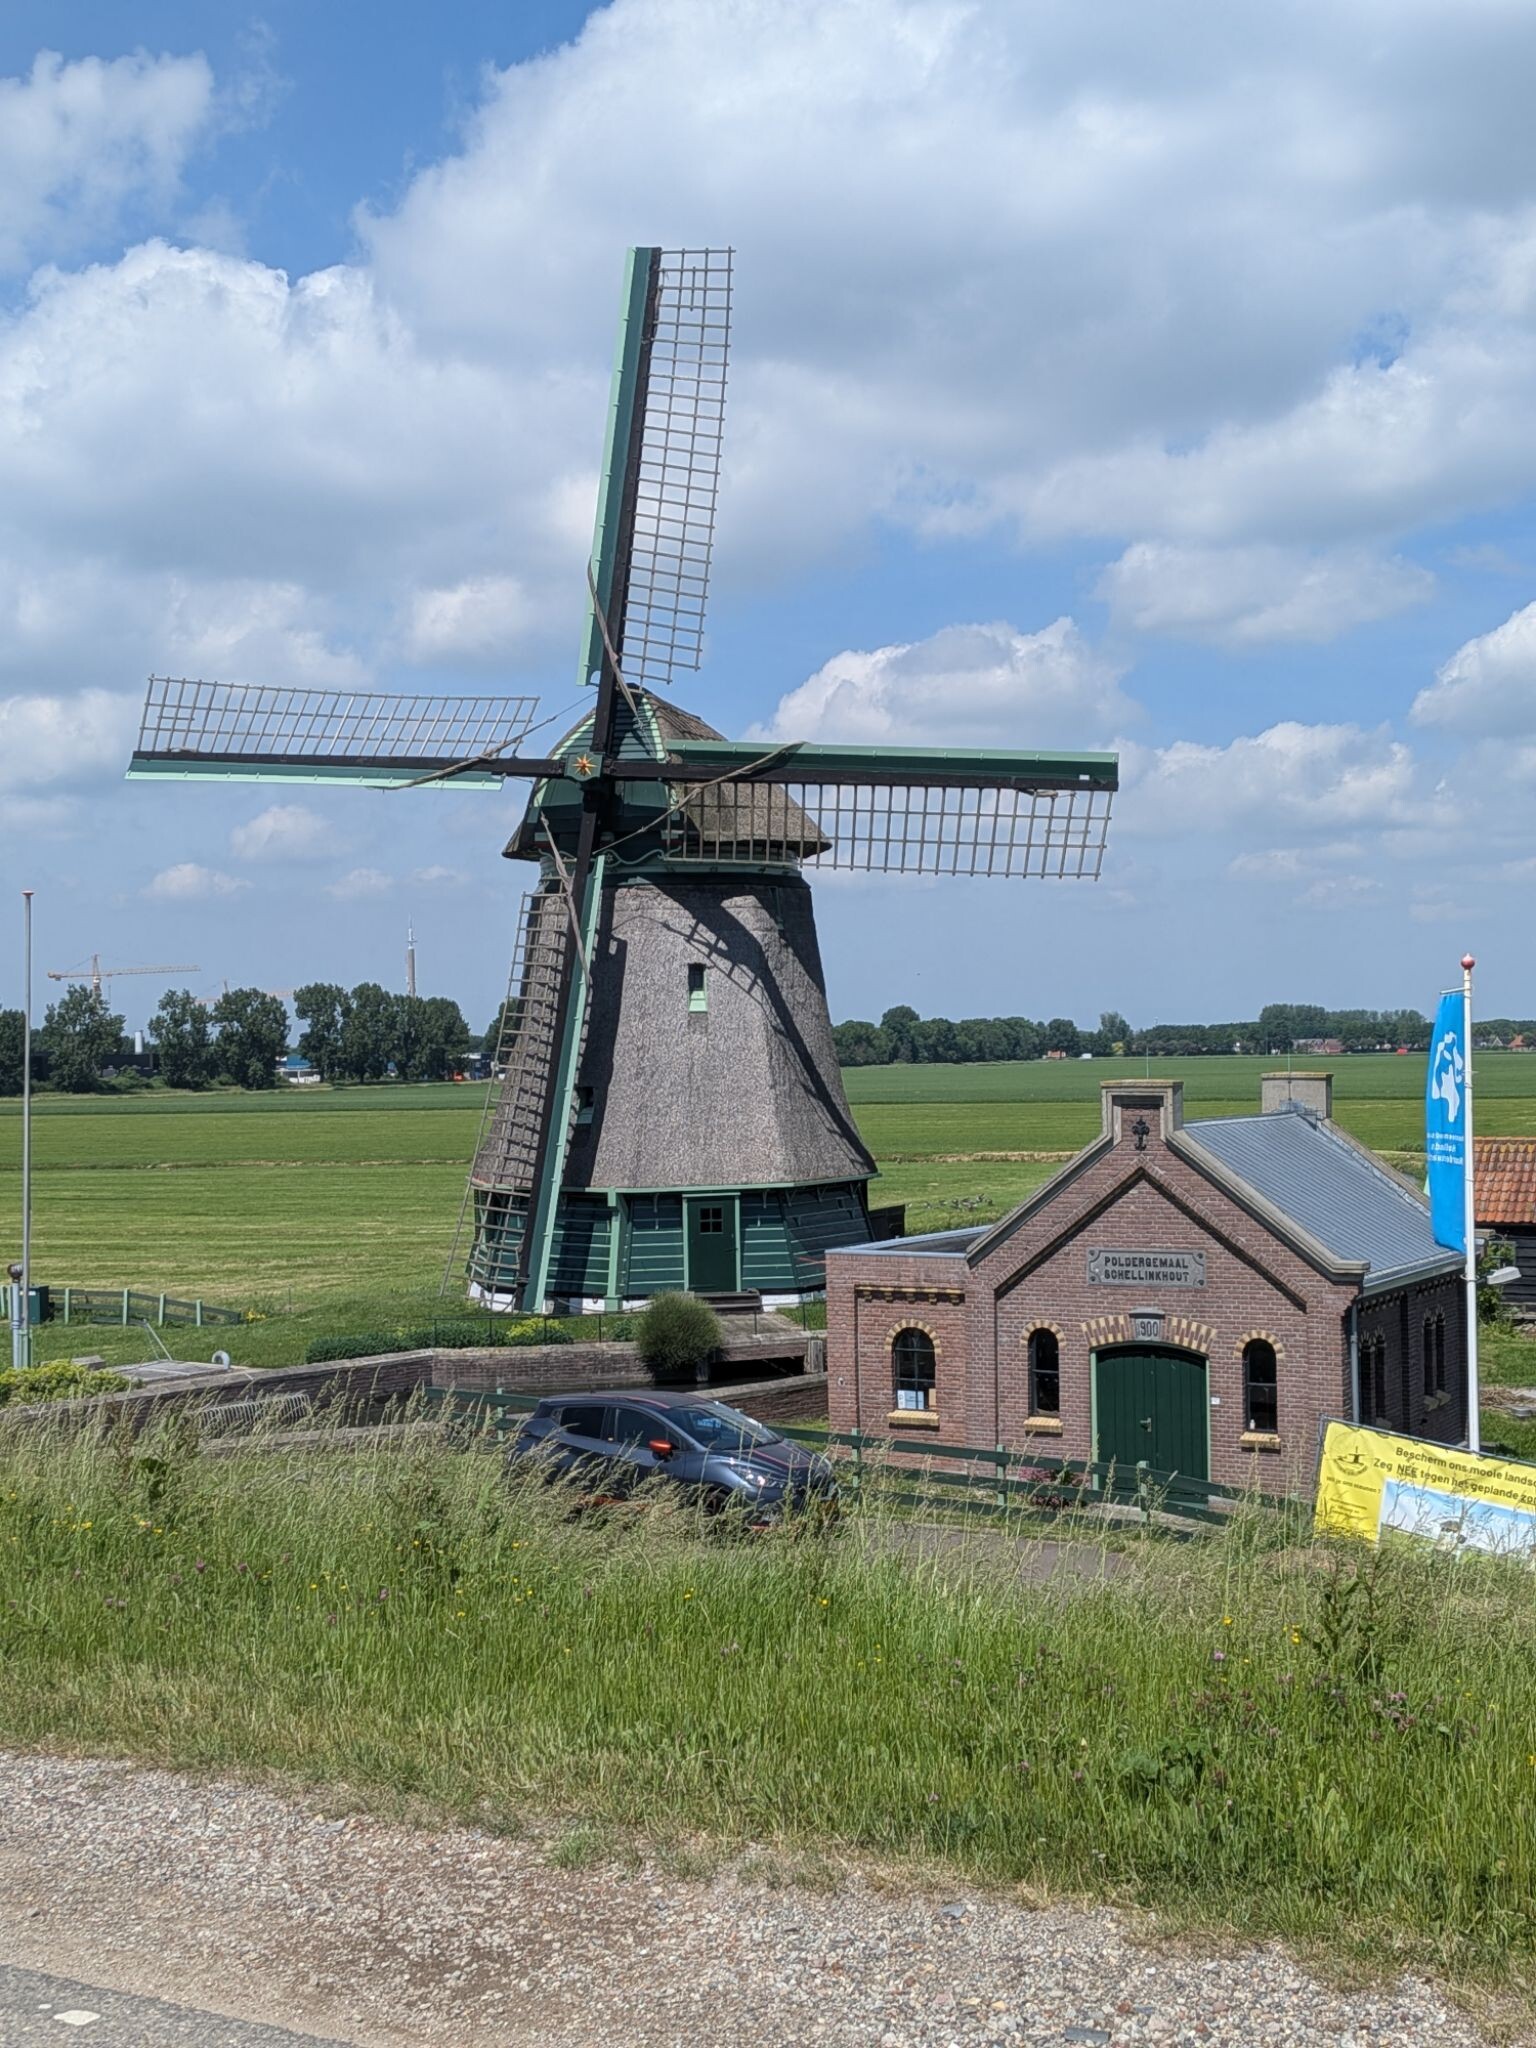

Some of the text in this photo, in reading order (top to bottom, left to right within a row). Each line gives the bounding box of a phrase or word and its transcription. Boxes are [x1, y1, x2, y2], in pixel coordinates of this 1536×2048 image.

[1104, 1256, 1189, 1269] POLDERGEMAAL
[1104, 1269, 1190, 1282] SCHELLINKHOUT
[1396, 1447, 1447, 1468] Bescherm
[1449, 1461, 1467, 1473] ons
[1469, 1467, 1503, 1480] mooie
[1373, 1458, 1393, 1472] Zeg
[1397, 1464, 1418, 1477] NEE
[1420, 1470, 1453, 1485] tegen
[1470, 1482, 1519, 1501] geplande
